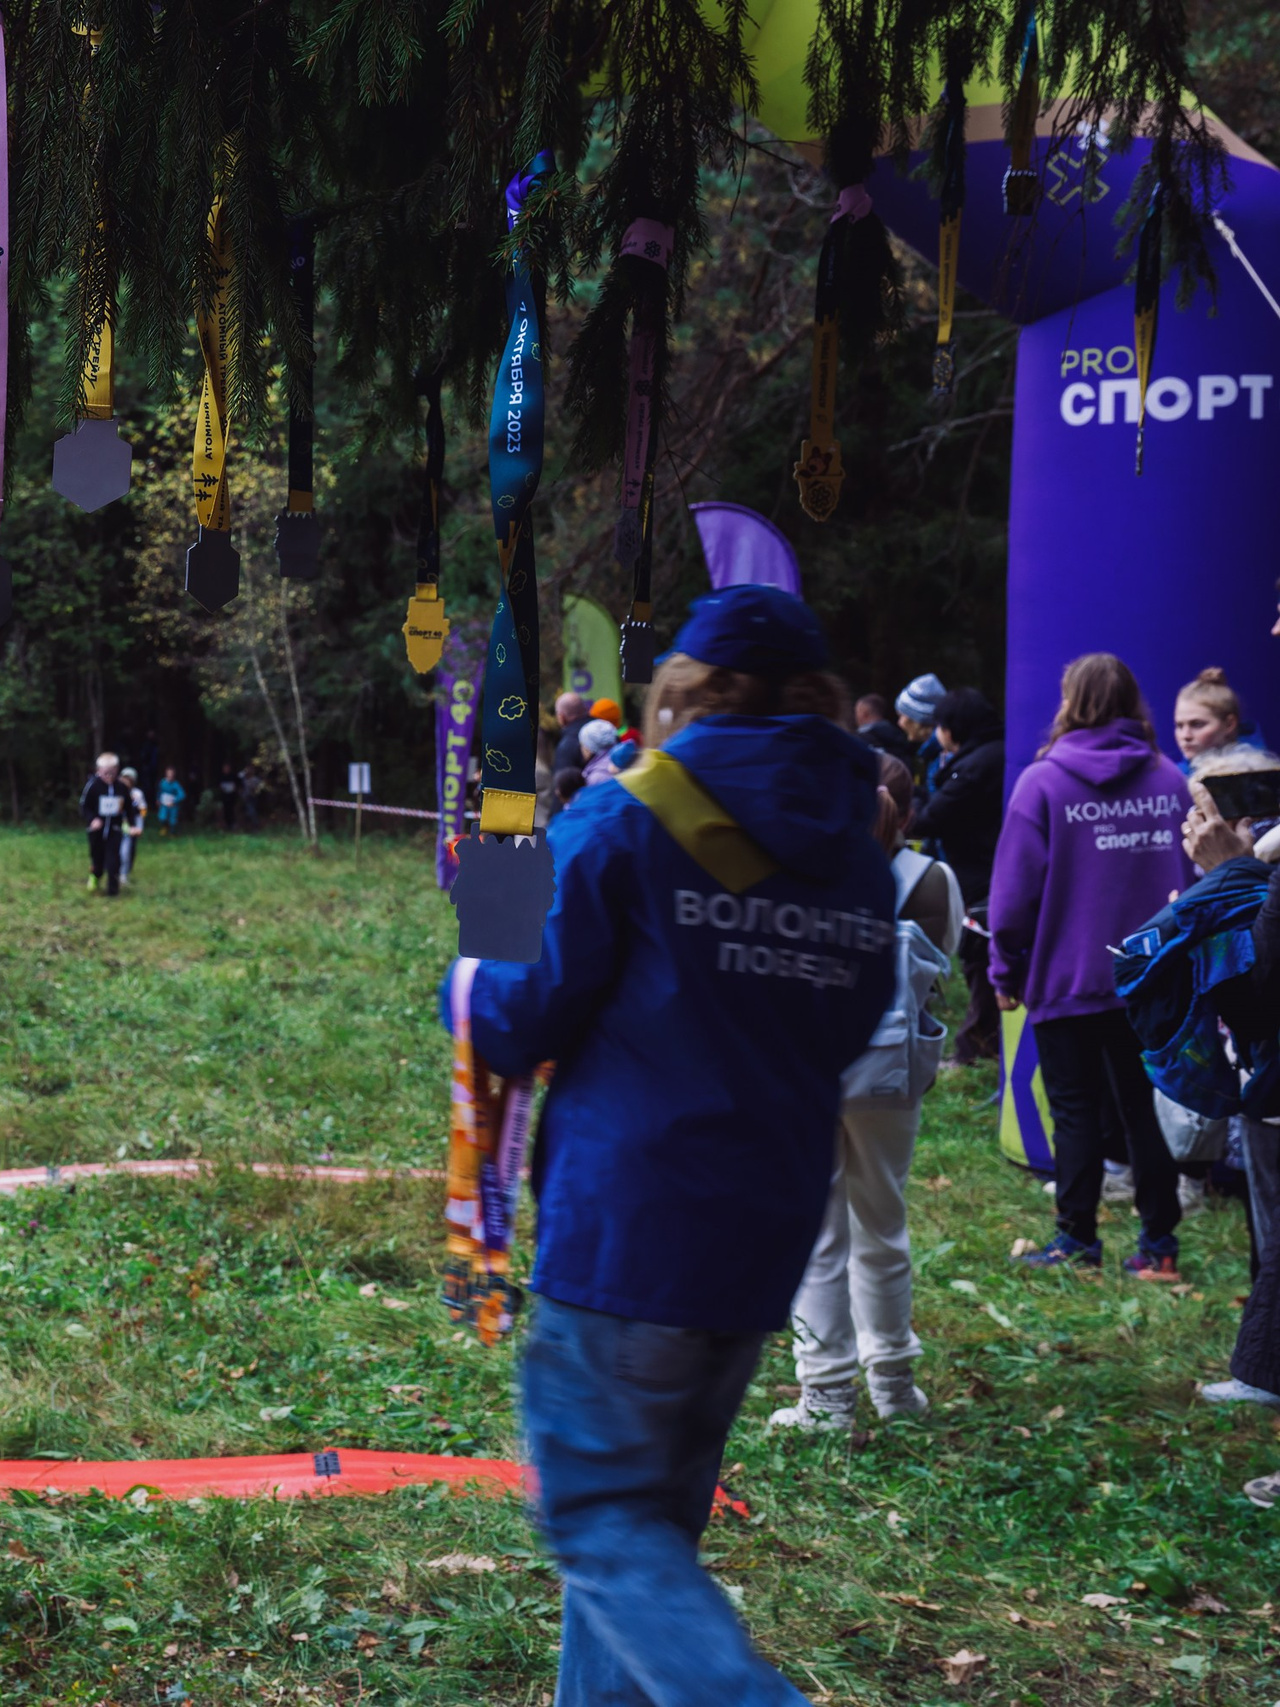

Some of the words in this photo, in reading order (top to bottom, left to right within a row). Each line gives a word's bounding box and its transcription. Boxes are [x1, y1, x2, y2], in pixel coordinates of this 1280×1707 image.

[520, 302, 527, 312] 7
[218, 303, 228, 360] АТОМНЫЙ
[509, 317, 528, 405] ОКТЯБРЯ
[1060, 345, 1135, 378] PRO
[1060, 374, 1273, 427] СПОРТ
[204, 402, 213, 460] АТОМНЫЙ
[507, 410, 522, 453] 2023
[450, 679, 475, 725] 40
[1064, 793, 1181, 823] КОМАНДА
[1095, 832, 1150, 850] СПОРТ
[1151, 829, 1173, 845] 40
